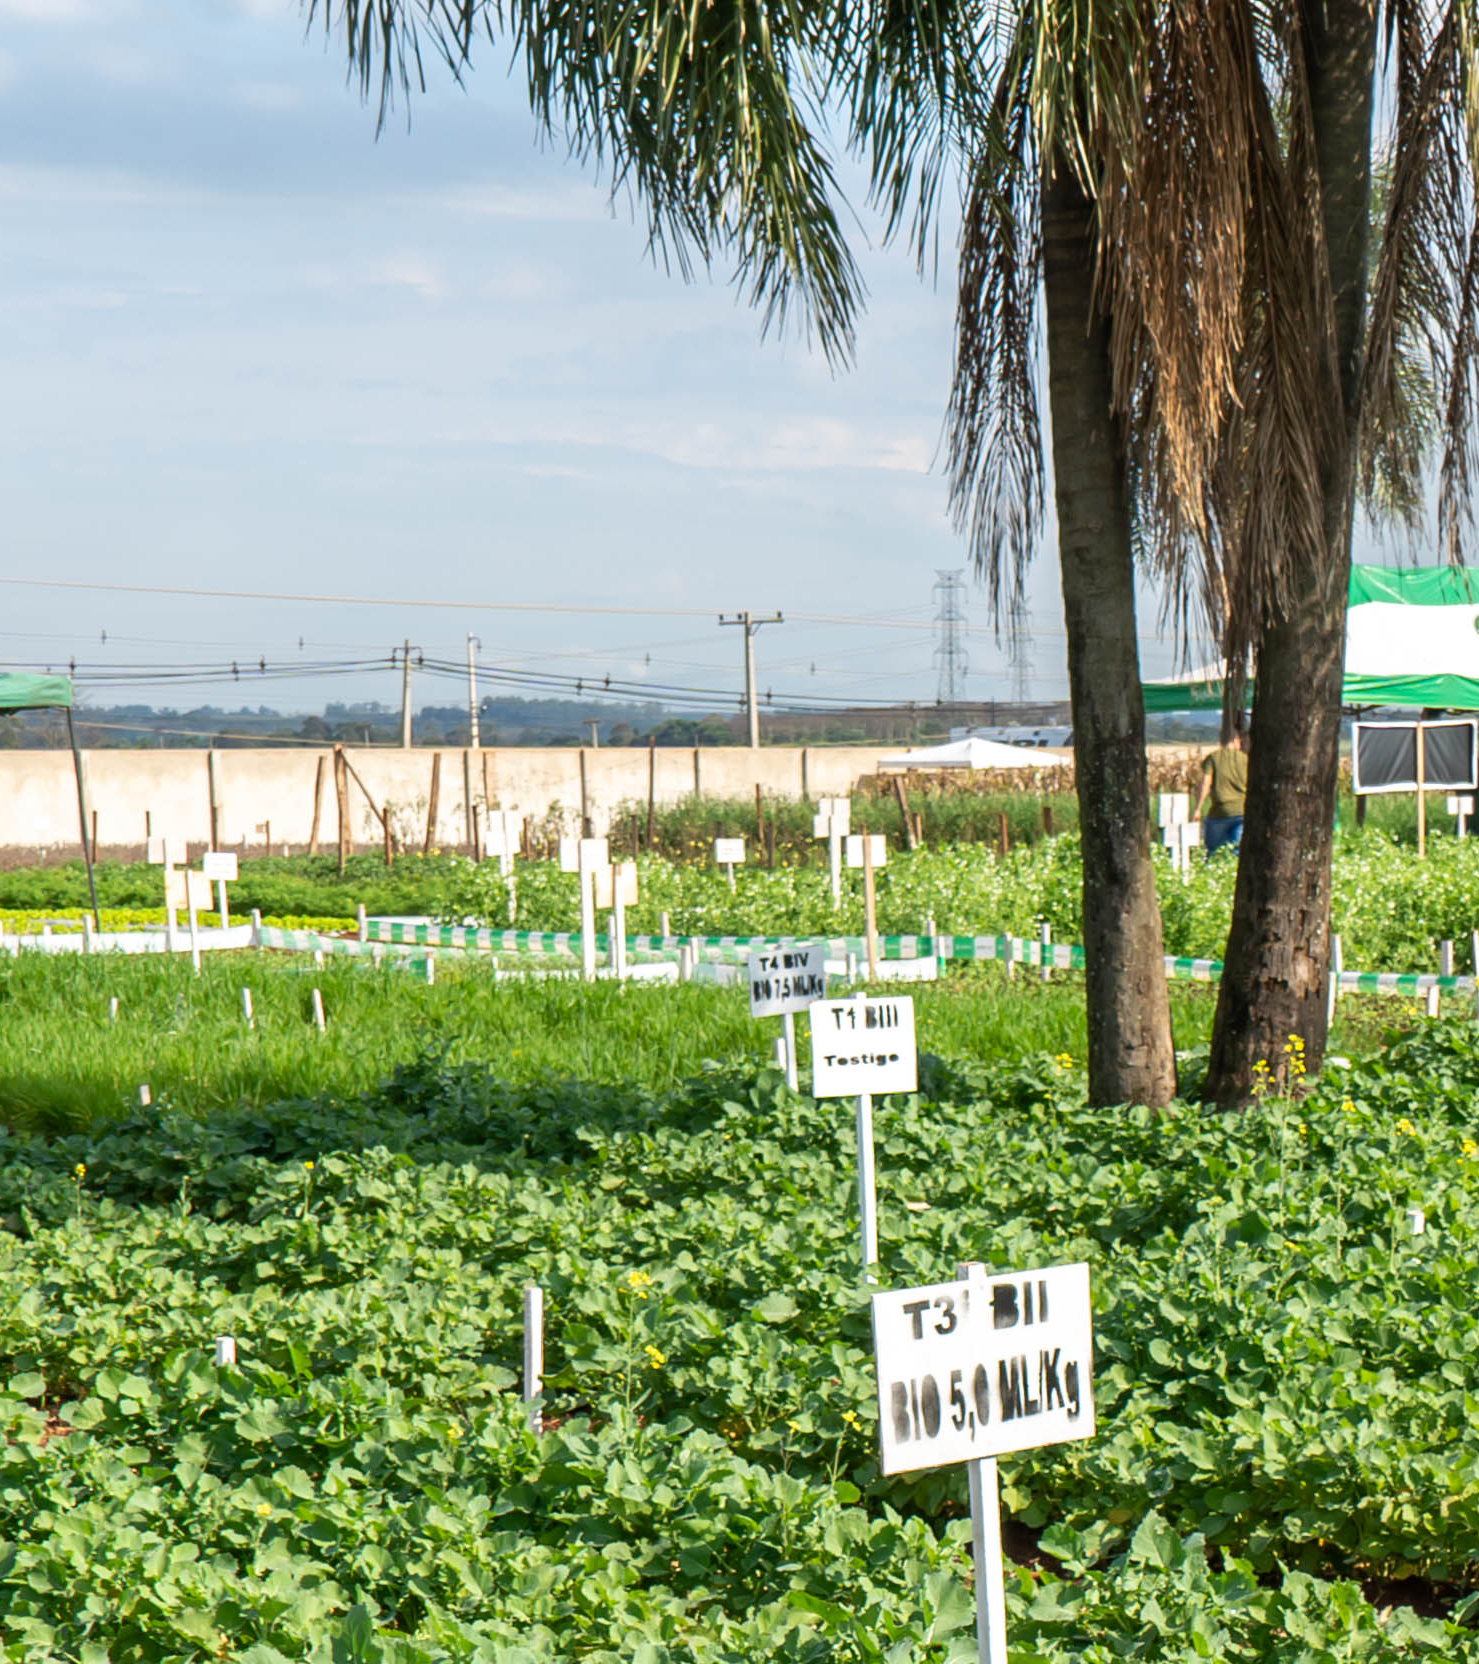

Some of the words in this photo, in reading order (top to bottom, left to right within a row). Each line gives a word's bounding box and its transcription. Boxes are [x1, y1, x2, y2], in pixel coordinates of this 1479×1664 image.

[759, 957, 778, 971] T4
[783, 953, 809, 969] BIV
[864, 1004, 899, 1029] BIII
[902, 1295, 958, 1340] T3
[991, 1280, 1049, 1330] BII
[890, 1373, 942, 1446] BIO
[950, 1363, 990, 1443] 5,0
